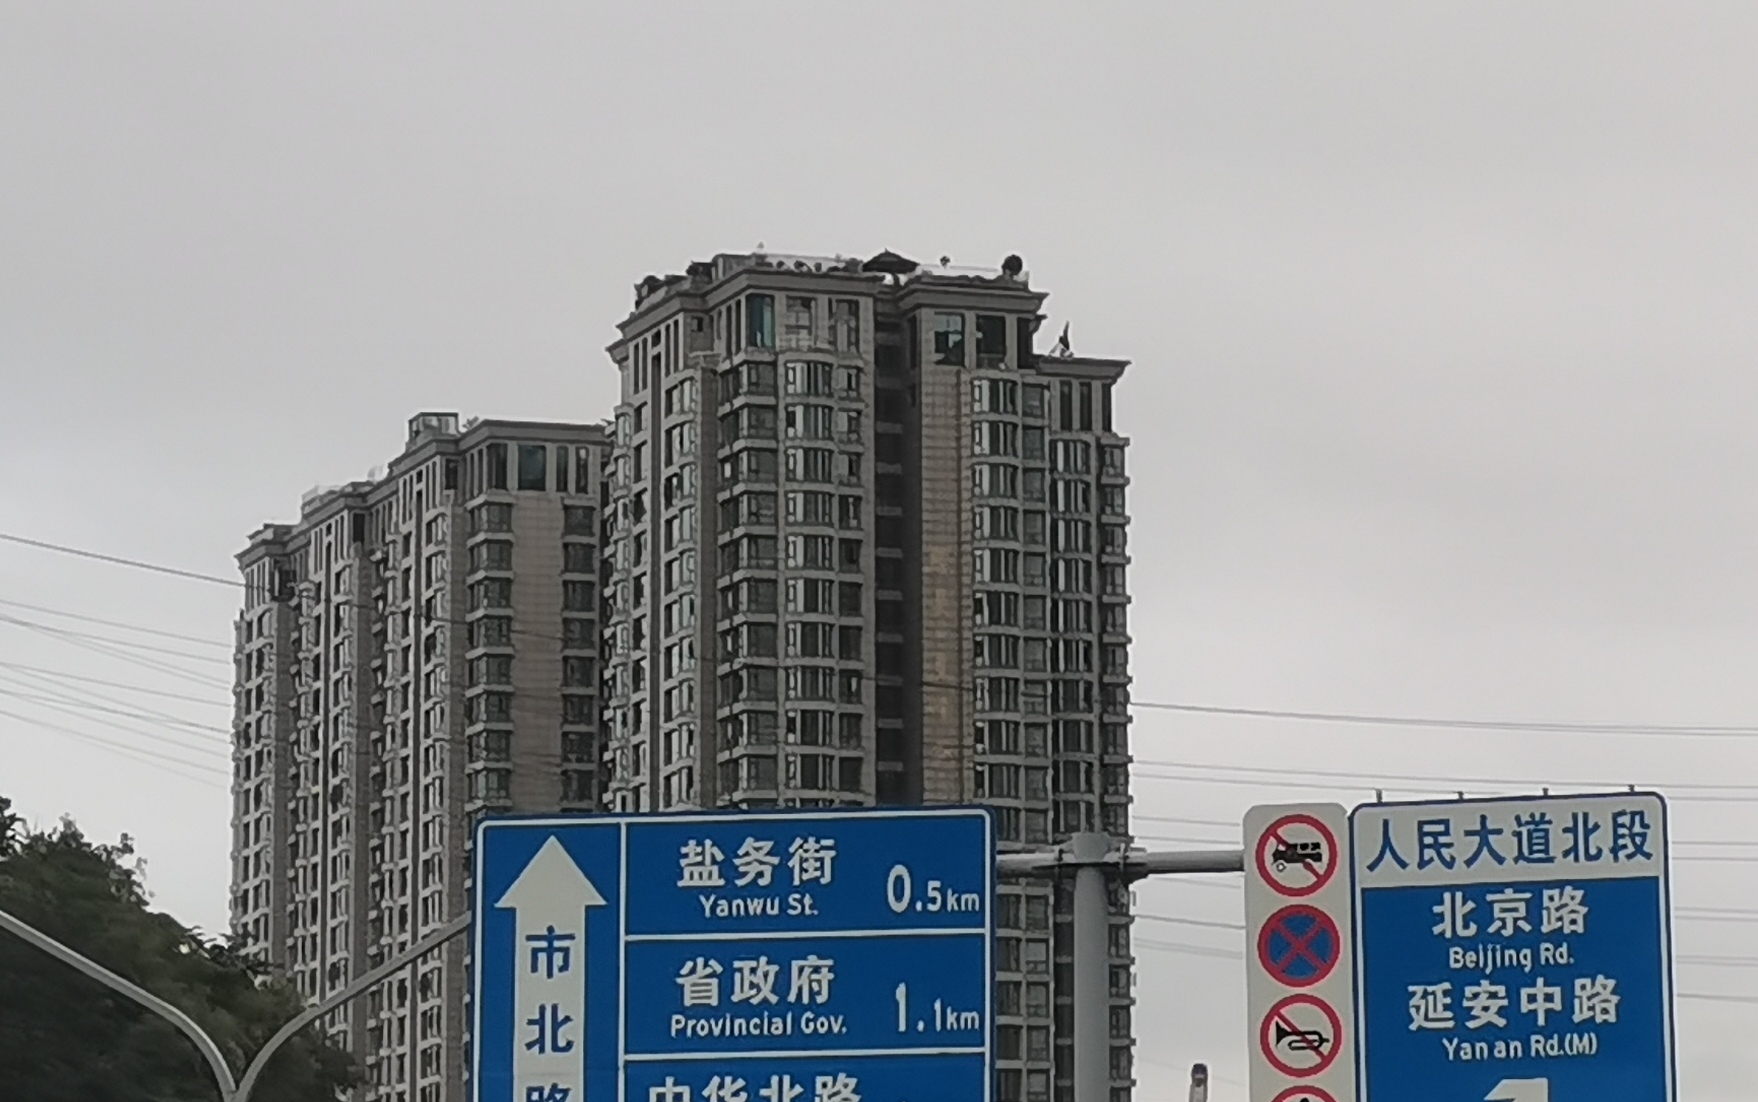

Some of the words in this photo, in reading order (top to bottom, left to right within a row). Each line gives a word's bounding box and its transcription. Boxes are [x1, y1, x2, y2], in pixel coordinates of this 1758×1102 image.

[678, 838, 835, 886] 盐务街
[1366, 809, 1653, 872] 人民大道北段
[700, 895, 778, 916] Yanwu
[788, 894, 817, 914] St.
[1432, 885, 1588, 938] 北京路
[677, 955, 834, 1006] 省政府
[1450, 945, 1531, 974] Beijing
[1541, 943, 1573, 964] Rd.
[672, 1012, 791, 1036] Provincial
[801, 1012, 845, 1033] Gov.
[1408, 974, 1620, 1030] 延安中路
